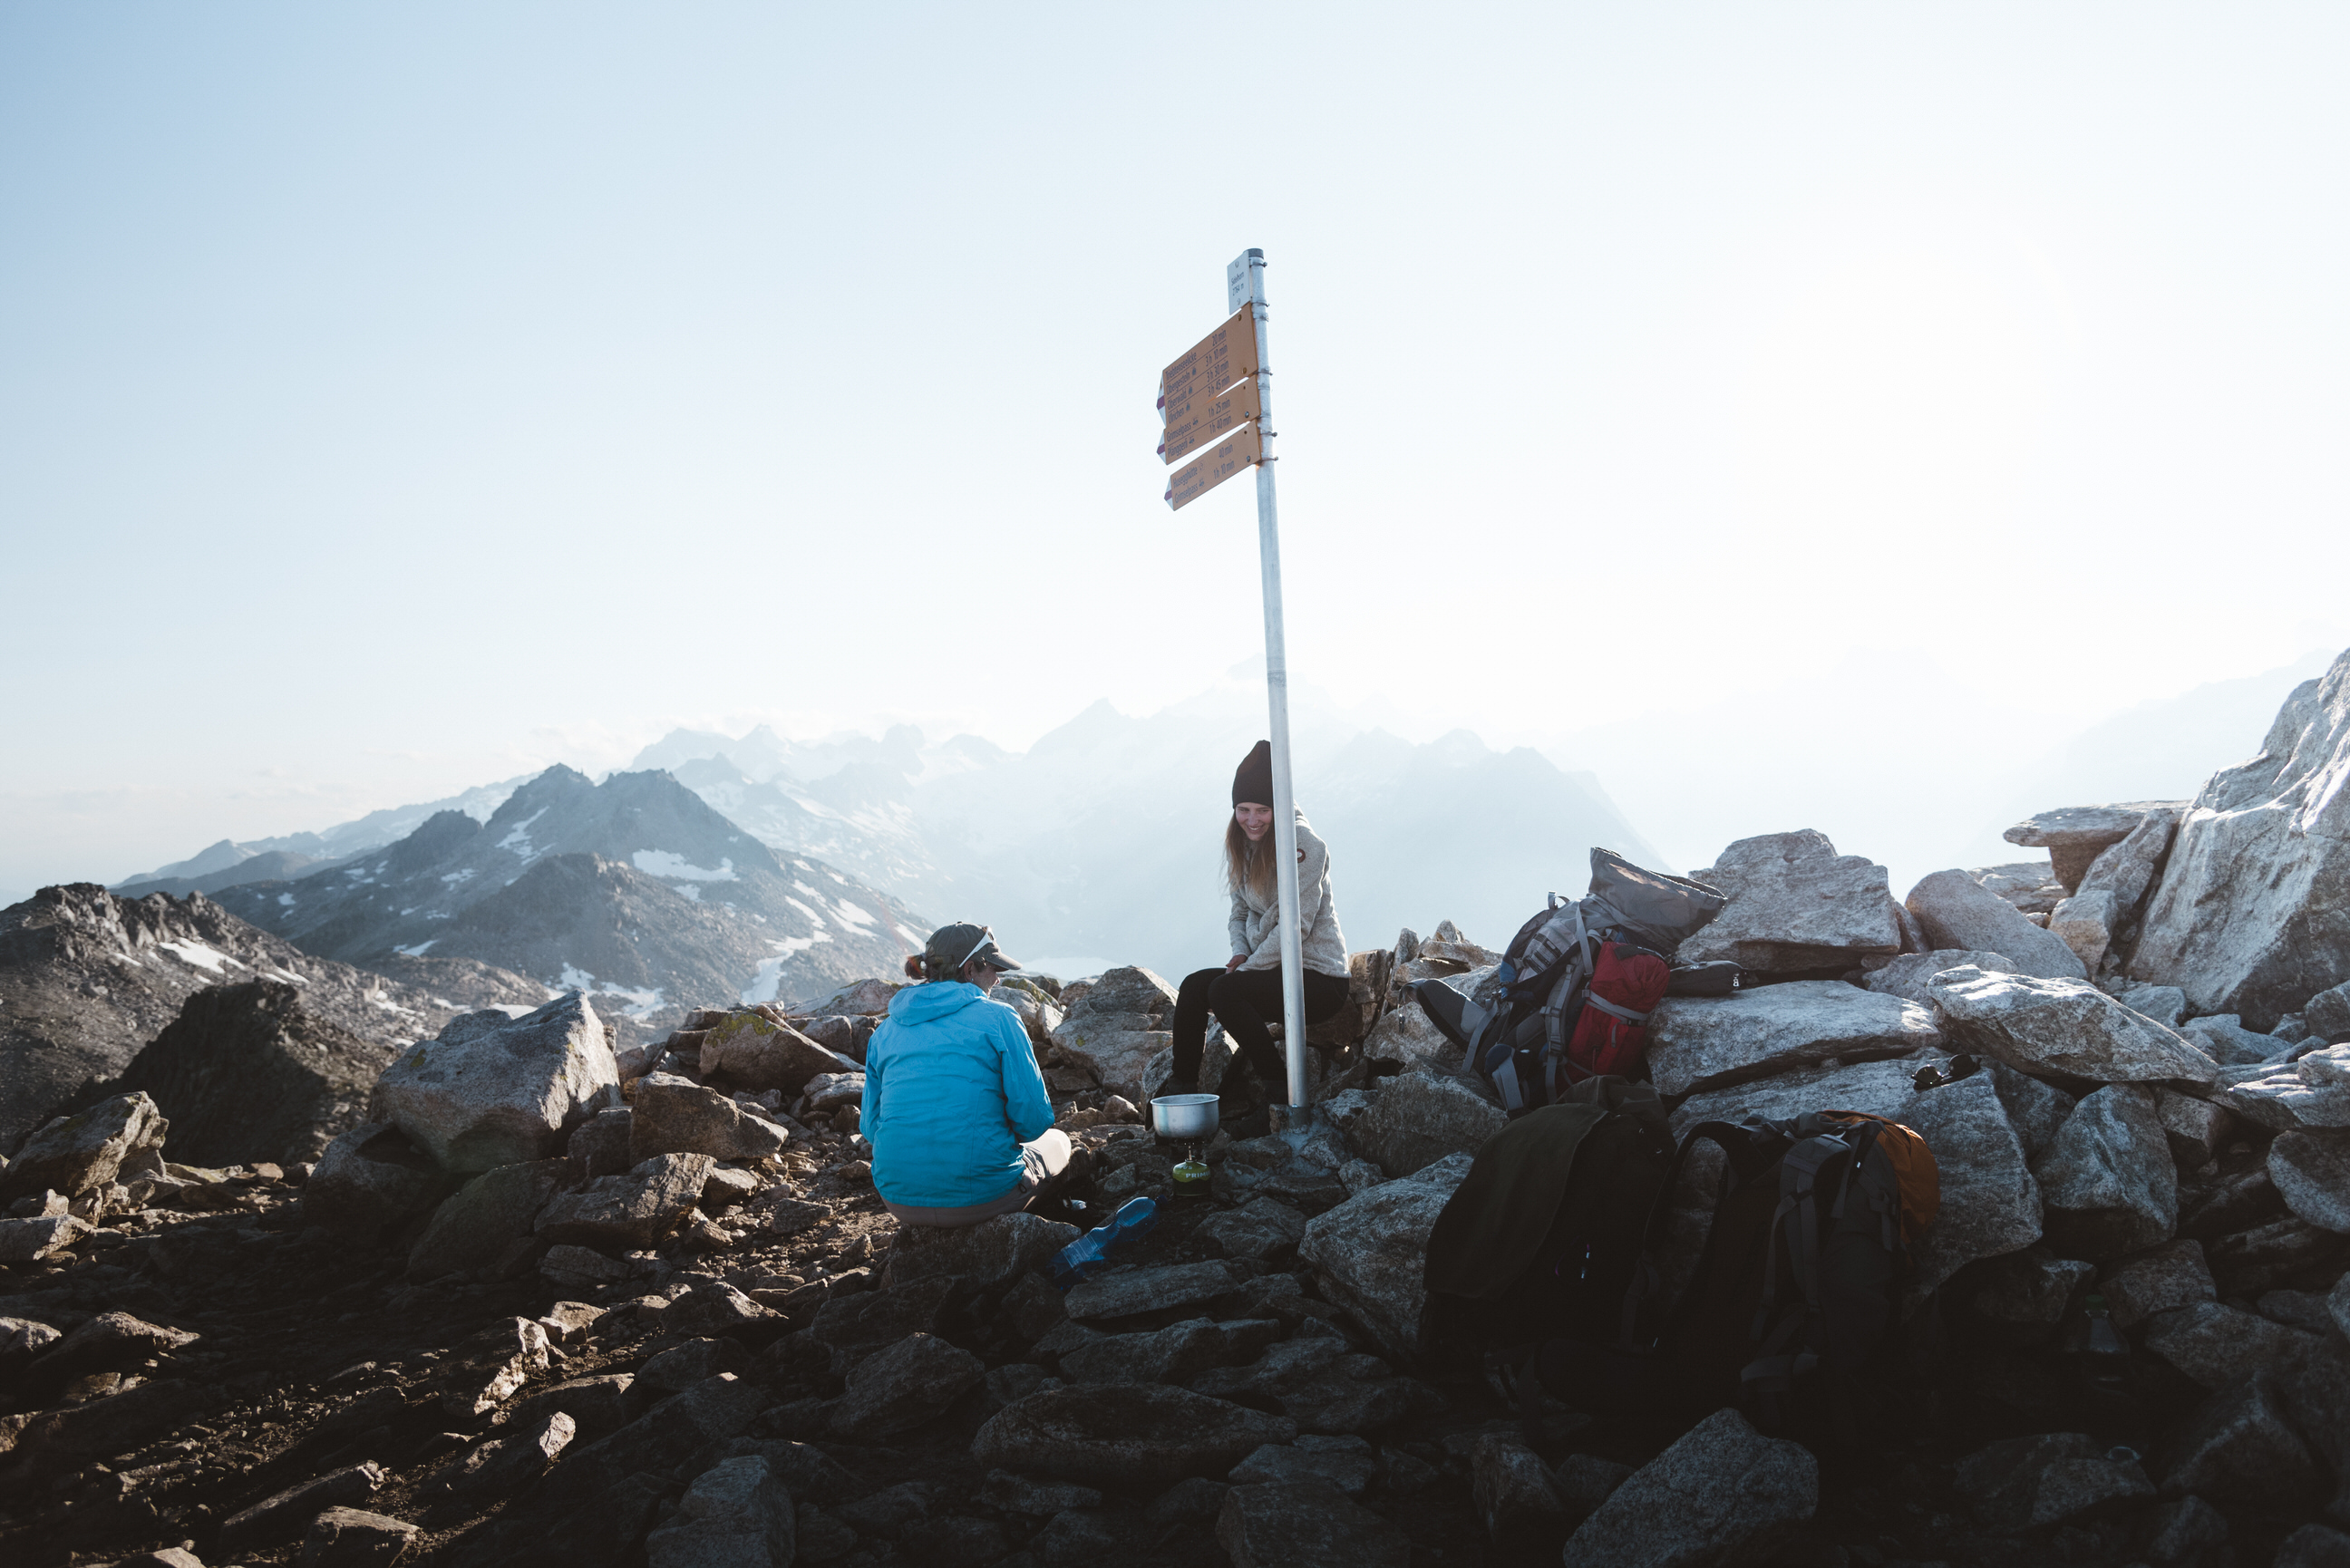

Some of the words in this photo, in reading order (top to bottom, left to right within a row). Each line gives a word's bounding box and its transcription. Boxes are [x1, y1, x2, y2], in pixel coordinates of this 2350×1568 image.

[1212, 334, 1218, 347] 20
[1219, 329, 1227, 342] min
[1167, 371, 1190, 395] Obergesteln
[1206, 356, 1209, 367] 3
[1209, 354, 1213, 364] h
[1214, 348, 1219, 360] 10
[1219, 344, 1228, 357] min
[1168, 387, 1187, 410] Oberwald
[1207, 371, 1210, 382] 3
[1210, 369, 1214, 379] h
[1215, 364, 1220, 377] 30
[1220, 360, 1229, 373] min
[1166, 421, 1191, 442] Grimselpass
[1211, 406, 1214, 416] h
[1216, 402, 1222, 414] 25
[1222, 397, 1231, 411] min
[1169, 407, 1185, 424] Ulrichen
[1208, 386, 1211, 397] 3
[1211, 384, 1214, 394] h
[1216, 378, 1221, 390] 45
[1222, 374, 1230, 387] min
[1212, 422, 1216, 433] h
[1217, 418, 1223, 430] 40
[1223, 414, 1232, 427] min
[1173, 466, 1198, 489] Husegghütte
[1219, 447, 1224, 459] 40
[1225, 442, 1233, 455] min
[1175, 483, 1198, 503] Grimselpass
[1216, 467, 1220, 478] h
[1221, 463, 1226, 475] 10
[1226, 458, 1235, 472] min
[1185, 1170, 1210, 1179] PRIMU
